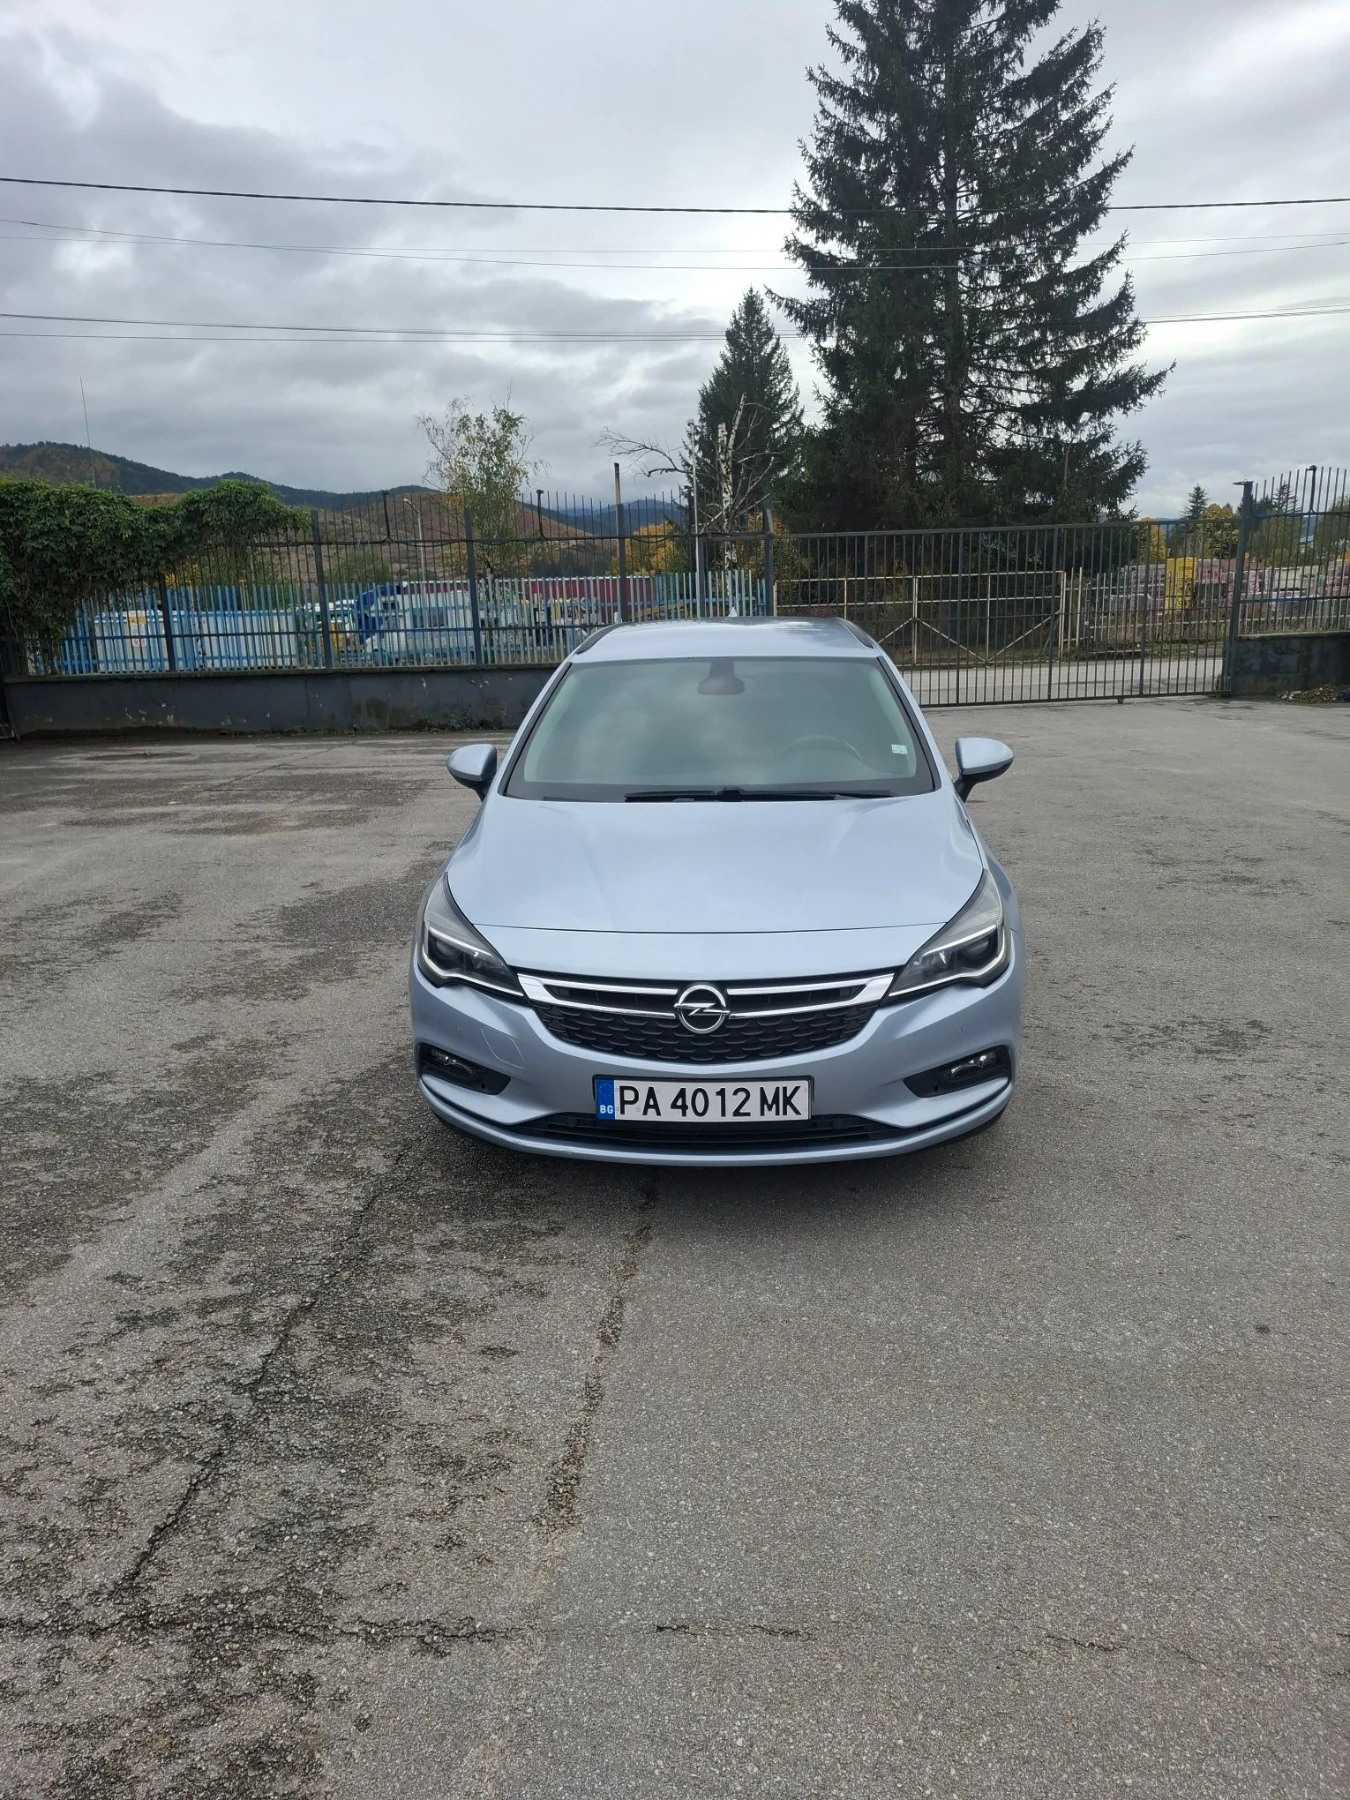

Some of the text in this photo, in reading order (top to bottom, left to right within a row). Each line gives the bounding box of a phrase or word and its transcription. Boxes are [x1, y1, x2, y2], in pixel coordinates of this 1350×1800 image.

[600, 1104, 614, 1115] BG
[619, 1085, 802, 1118] PA 4012 MK
